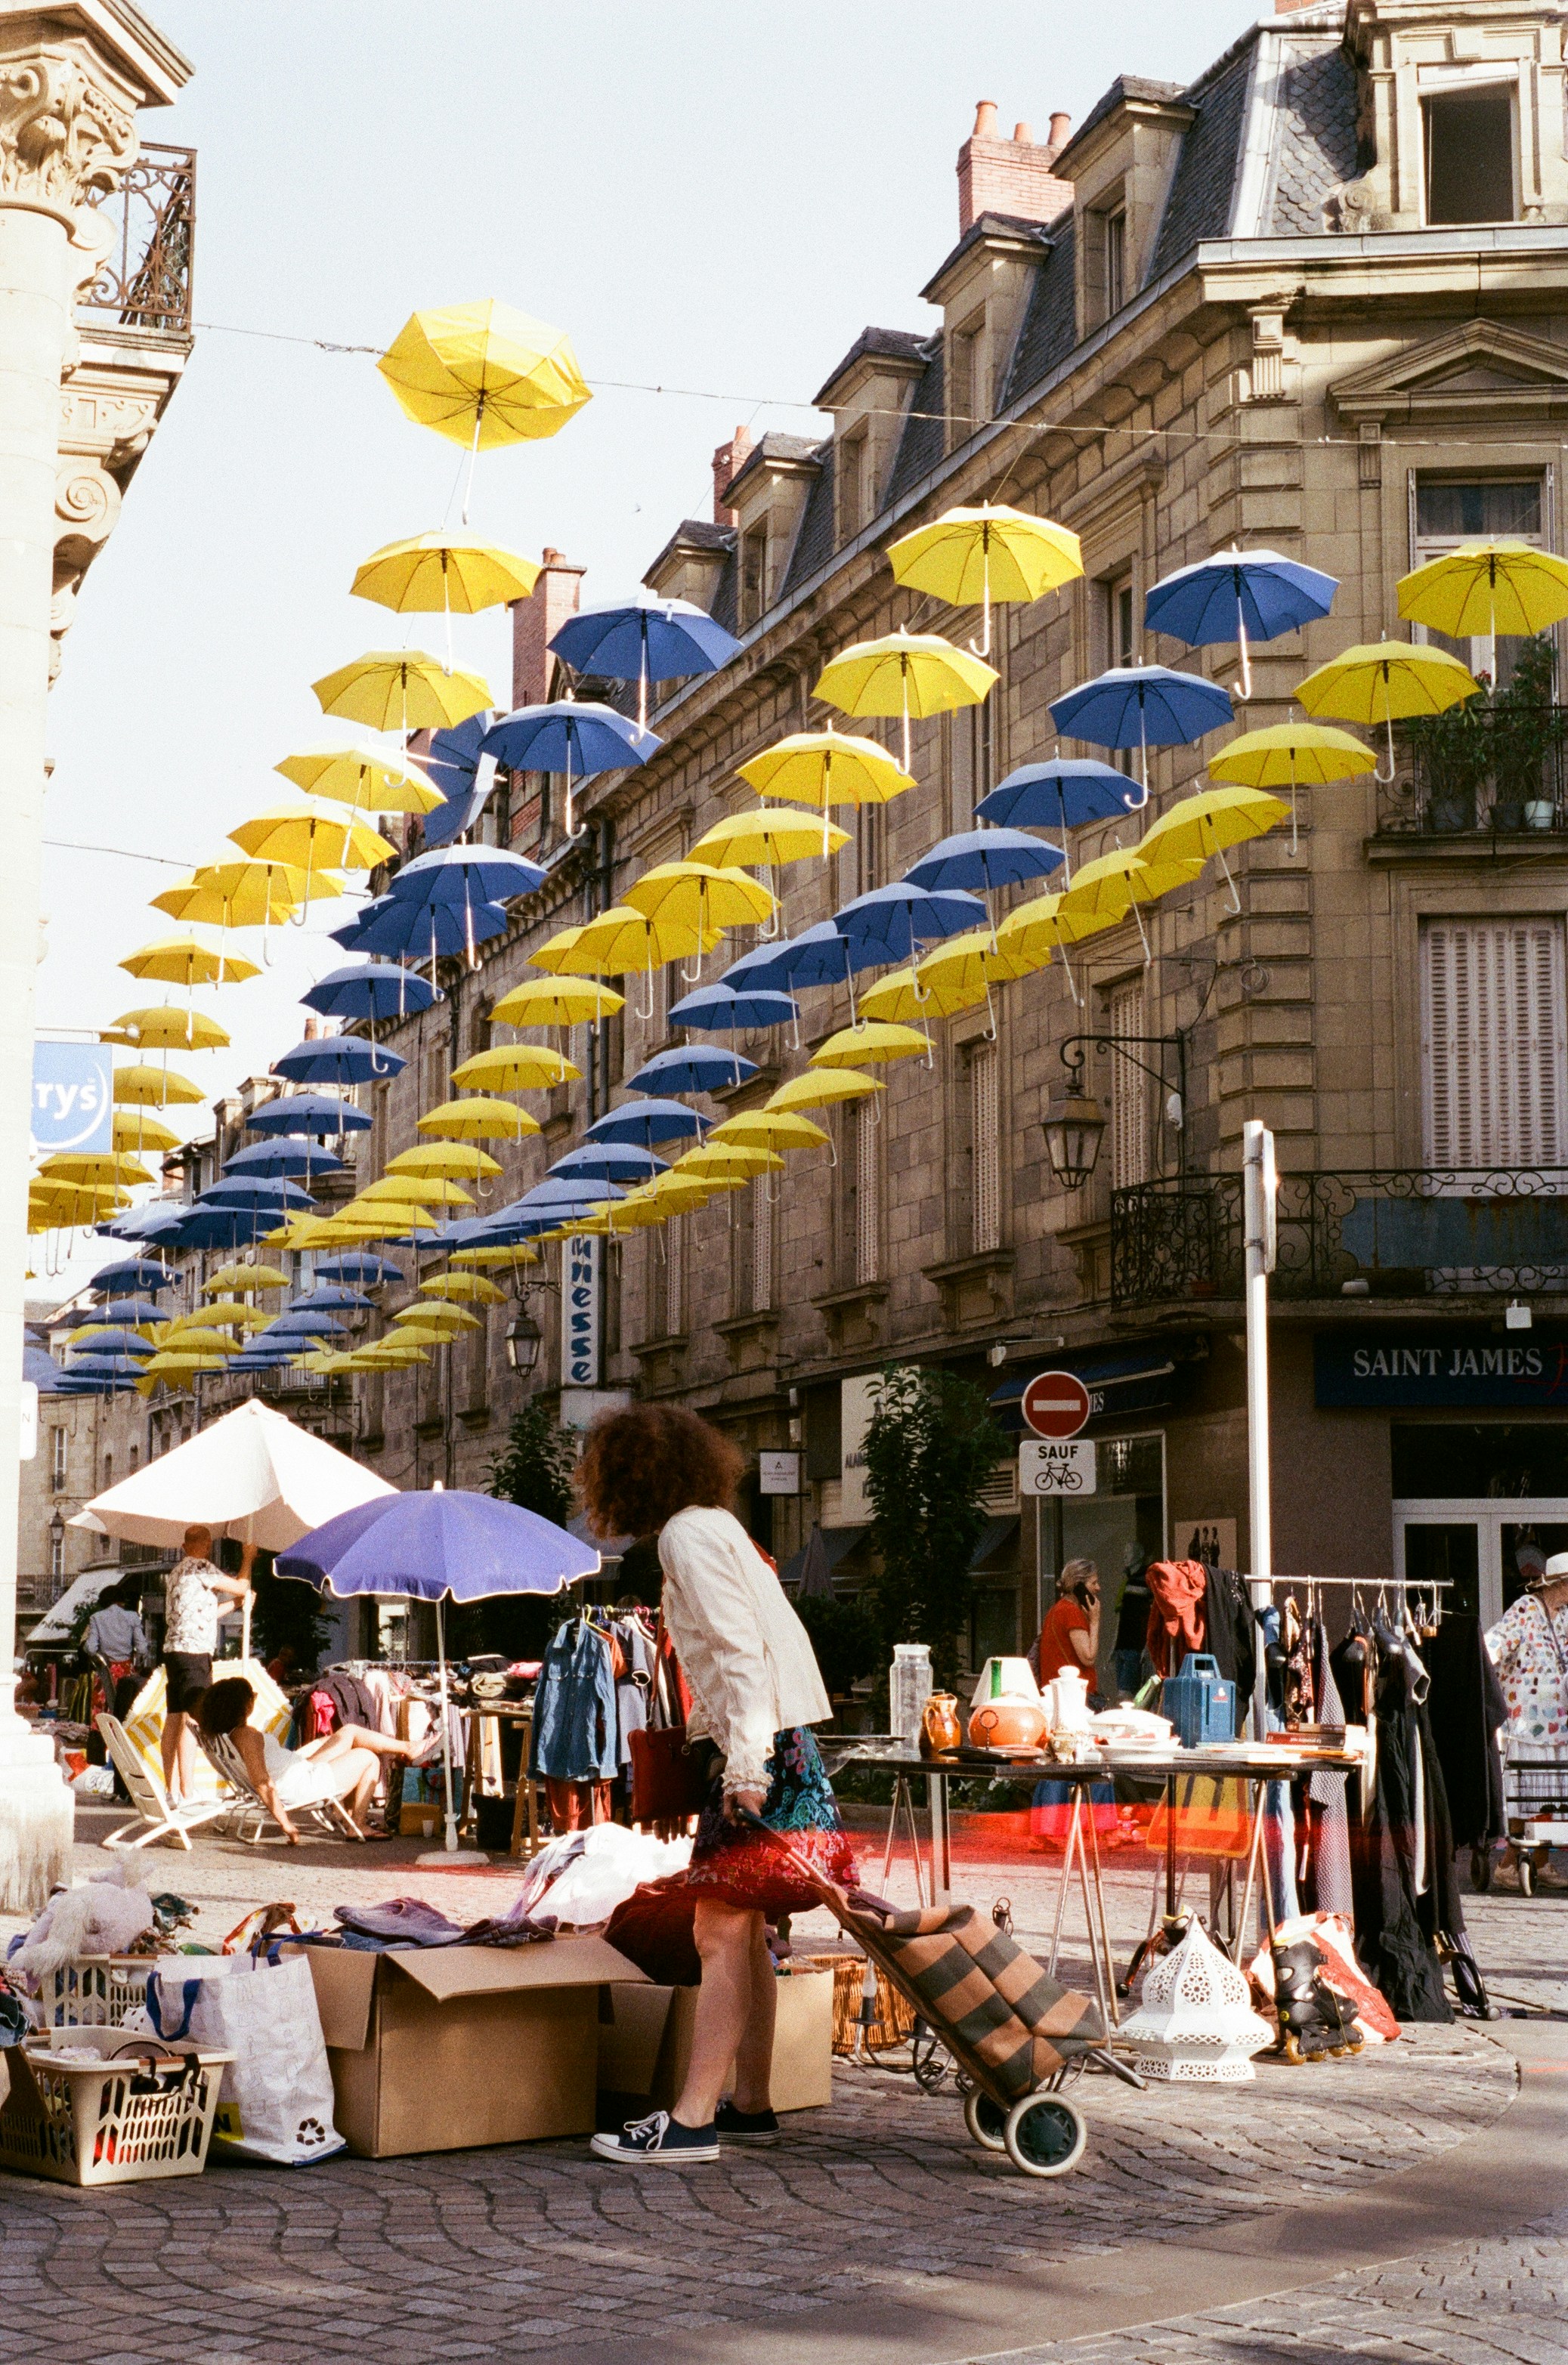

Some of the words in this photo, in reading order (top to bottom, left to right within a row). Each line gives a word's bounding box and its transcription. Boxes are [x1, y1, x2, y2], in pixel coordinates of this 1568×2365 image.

[34, 1081, 97, 1121] rys
[1353, 1349, 1443, 1377] SAINT
[1448, 1347, 1543, 1377] JAMES
[1038, 1445, 1079, 1460] SAUF
